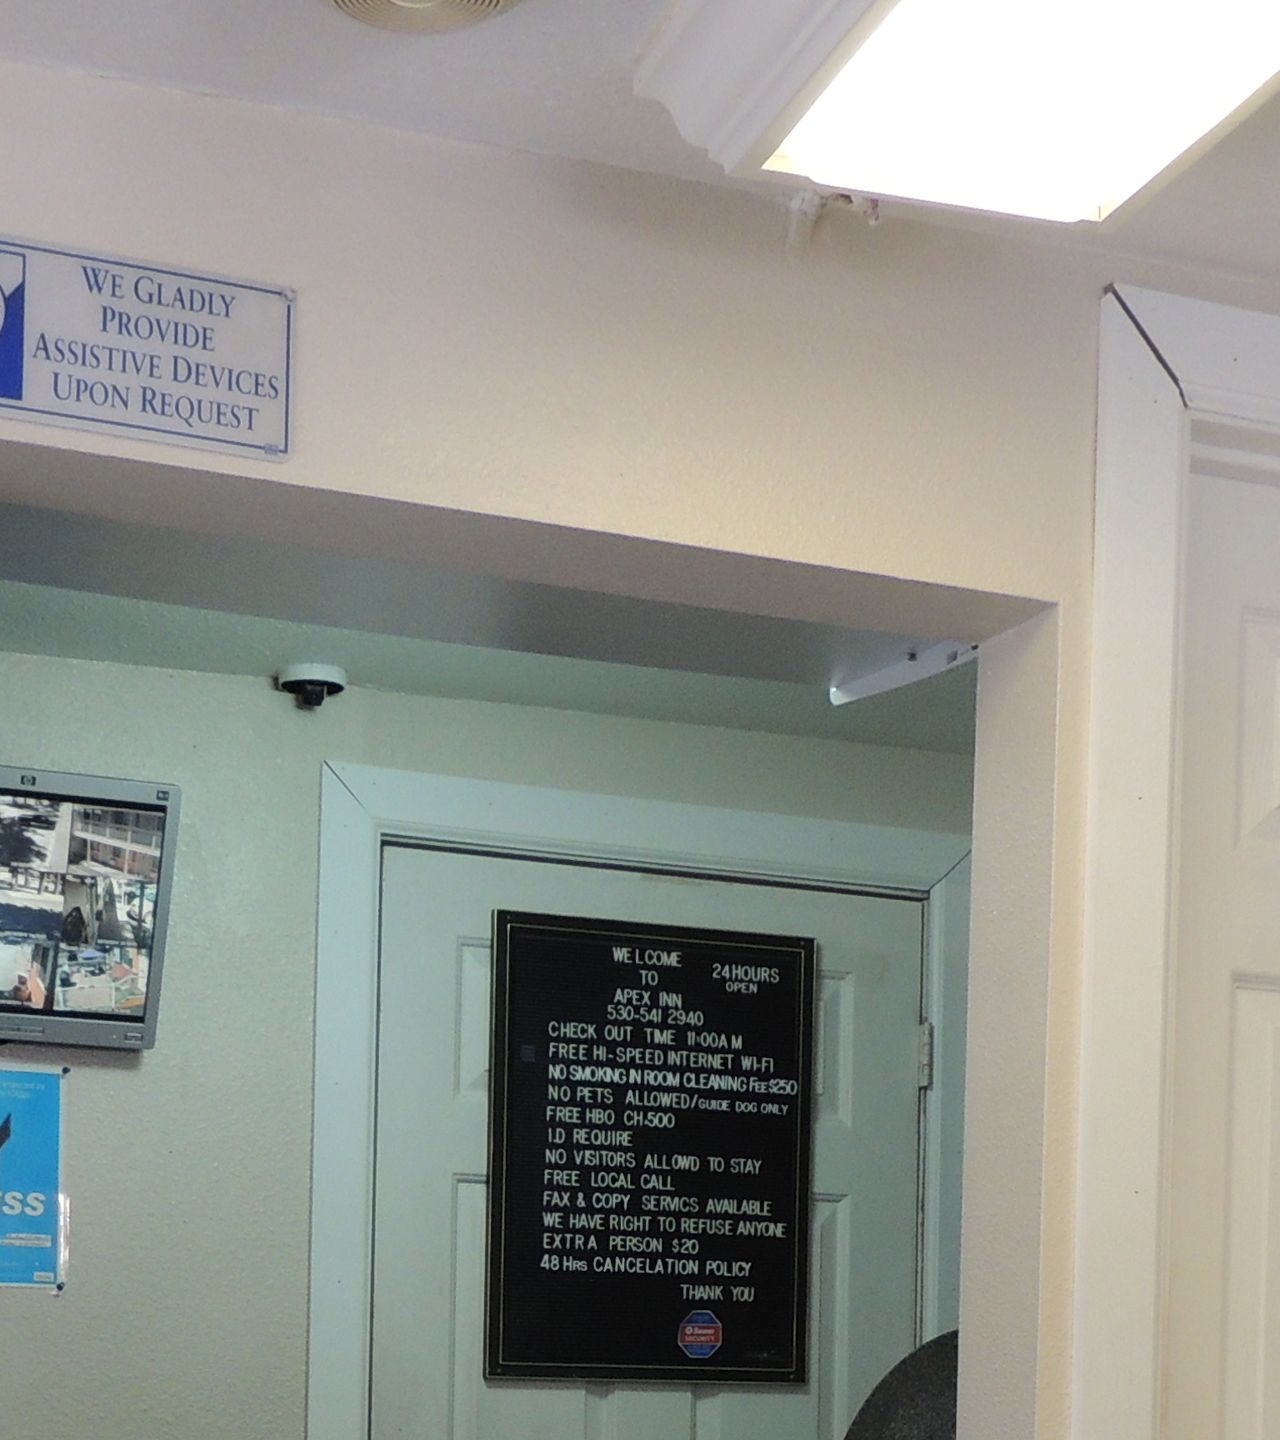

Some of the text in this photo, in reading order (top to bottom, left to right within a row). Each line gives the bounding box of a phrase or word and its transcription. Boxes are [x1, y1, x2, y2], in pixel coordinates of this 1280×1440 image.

[81, 265, 236, 318] WE GLADLY
[100, 305, 216, 351] PROVIDE
[32, 331, 280, 400] ASSISTIVE DEVICES
[53, 372, 259, 432] UPON REQUEST
[612, 947, 682, 967] WELCOME
[640, 970, 659, 986] TO
[726, 982, 758, 994] OPEN
[614, 988, 682, 1008] APEX INN
[668, 1009, 704, 1026] 2940
[548, 1021, 597, 1039] CHECK
[605, 1025, 633, 1042] OUT
[549, 1043, 588, 1061] FREE
[668, 1051, 734, 1070] INTERNET
[548, 1064, 566, 1080] NO
[570, 1065, 626, 1084] SMOKING
[629, 1068, 641, 1085] IN
[644, 1069, 680, 1087] ROOM
[683, 1073, 747, 1091] CLEANING
[548, 1085, 570, 1102] NO
[577, 1087, 613, 1104] PETS
[735, 1102, 757, 1113] DOG
[761, 1103, 788, 1115] ONLY
[546, 1106, 581, 1123] FREE
[586, 1109, 615, 1125] HBO
[573, 1129, 633, 1146] REQUIRE
[545, 1149, 762, 1174] NO VISITORS ALLOWD TO STAY
[544, 1170, 675, 1191] FREE LOCAL CALL
[543, 1192, 570, 1208] FAX
[577, 1192, 585, 1207] &
[592, 1193, 631, 1210] COPY
[706, 1199, 772, 1216] AVAILABLE
[542, 1212, 787, 1238] WE HAVE RIGHT TO REFUSE ANYONE
[543, 1233, 699, 1254] EXTRA PERSON $20
[540, 1254, 560, 1271] 48
[593, 1256, 698, 1275] CANCELATION
[706, 1260, 752, 1277] POLICY
[680, 1284, 754, 1302] THANK YOU
